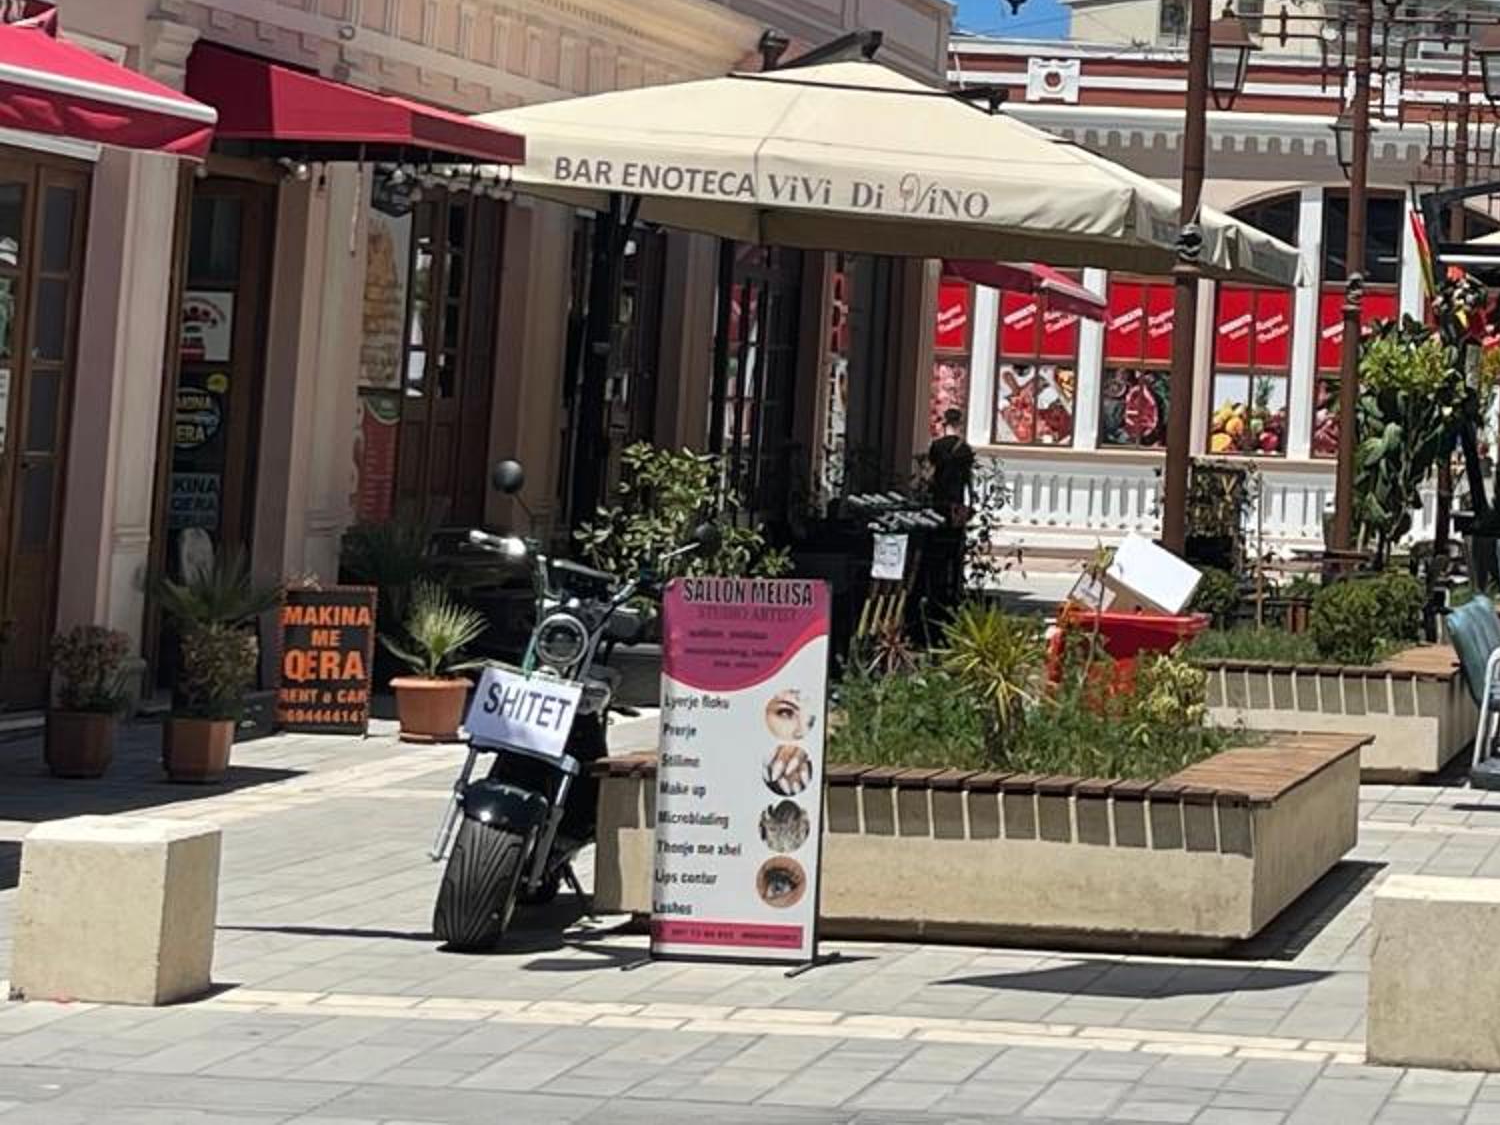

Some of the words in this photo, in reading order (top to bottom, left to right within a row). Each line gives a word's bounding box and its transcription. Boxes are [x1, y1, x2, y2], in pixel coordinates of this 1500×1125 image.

[554, 156, 612, 185] BAR
[621, 162, 756, 198] ENOTECA
[851, 181, 884, 210] Di
[683, 578, 746, 604] SALLON
[750, 580, 813, 606] MELISA
[280, 605, 371, 626] MAKINA
[310, 629, 342, 647] ME
[283, 648, 365, 682] QERA
[483, 681, 572, 732] SHITET
[692, 786, 706, 800] up
[658, 810, 729, 830] Microblading
[697, 843, 715, 855] me
[655, 868, 679, 887] Lips
